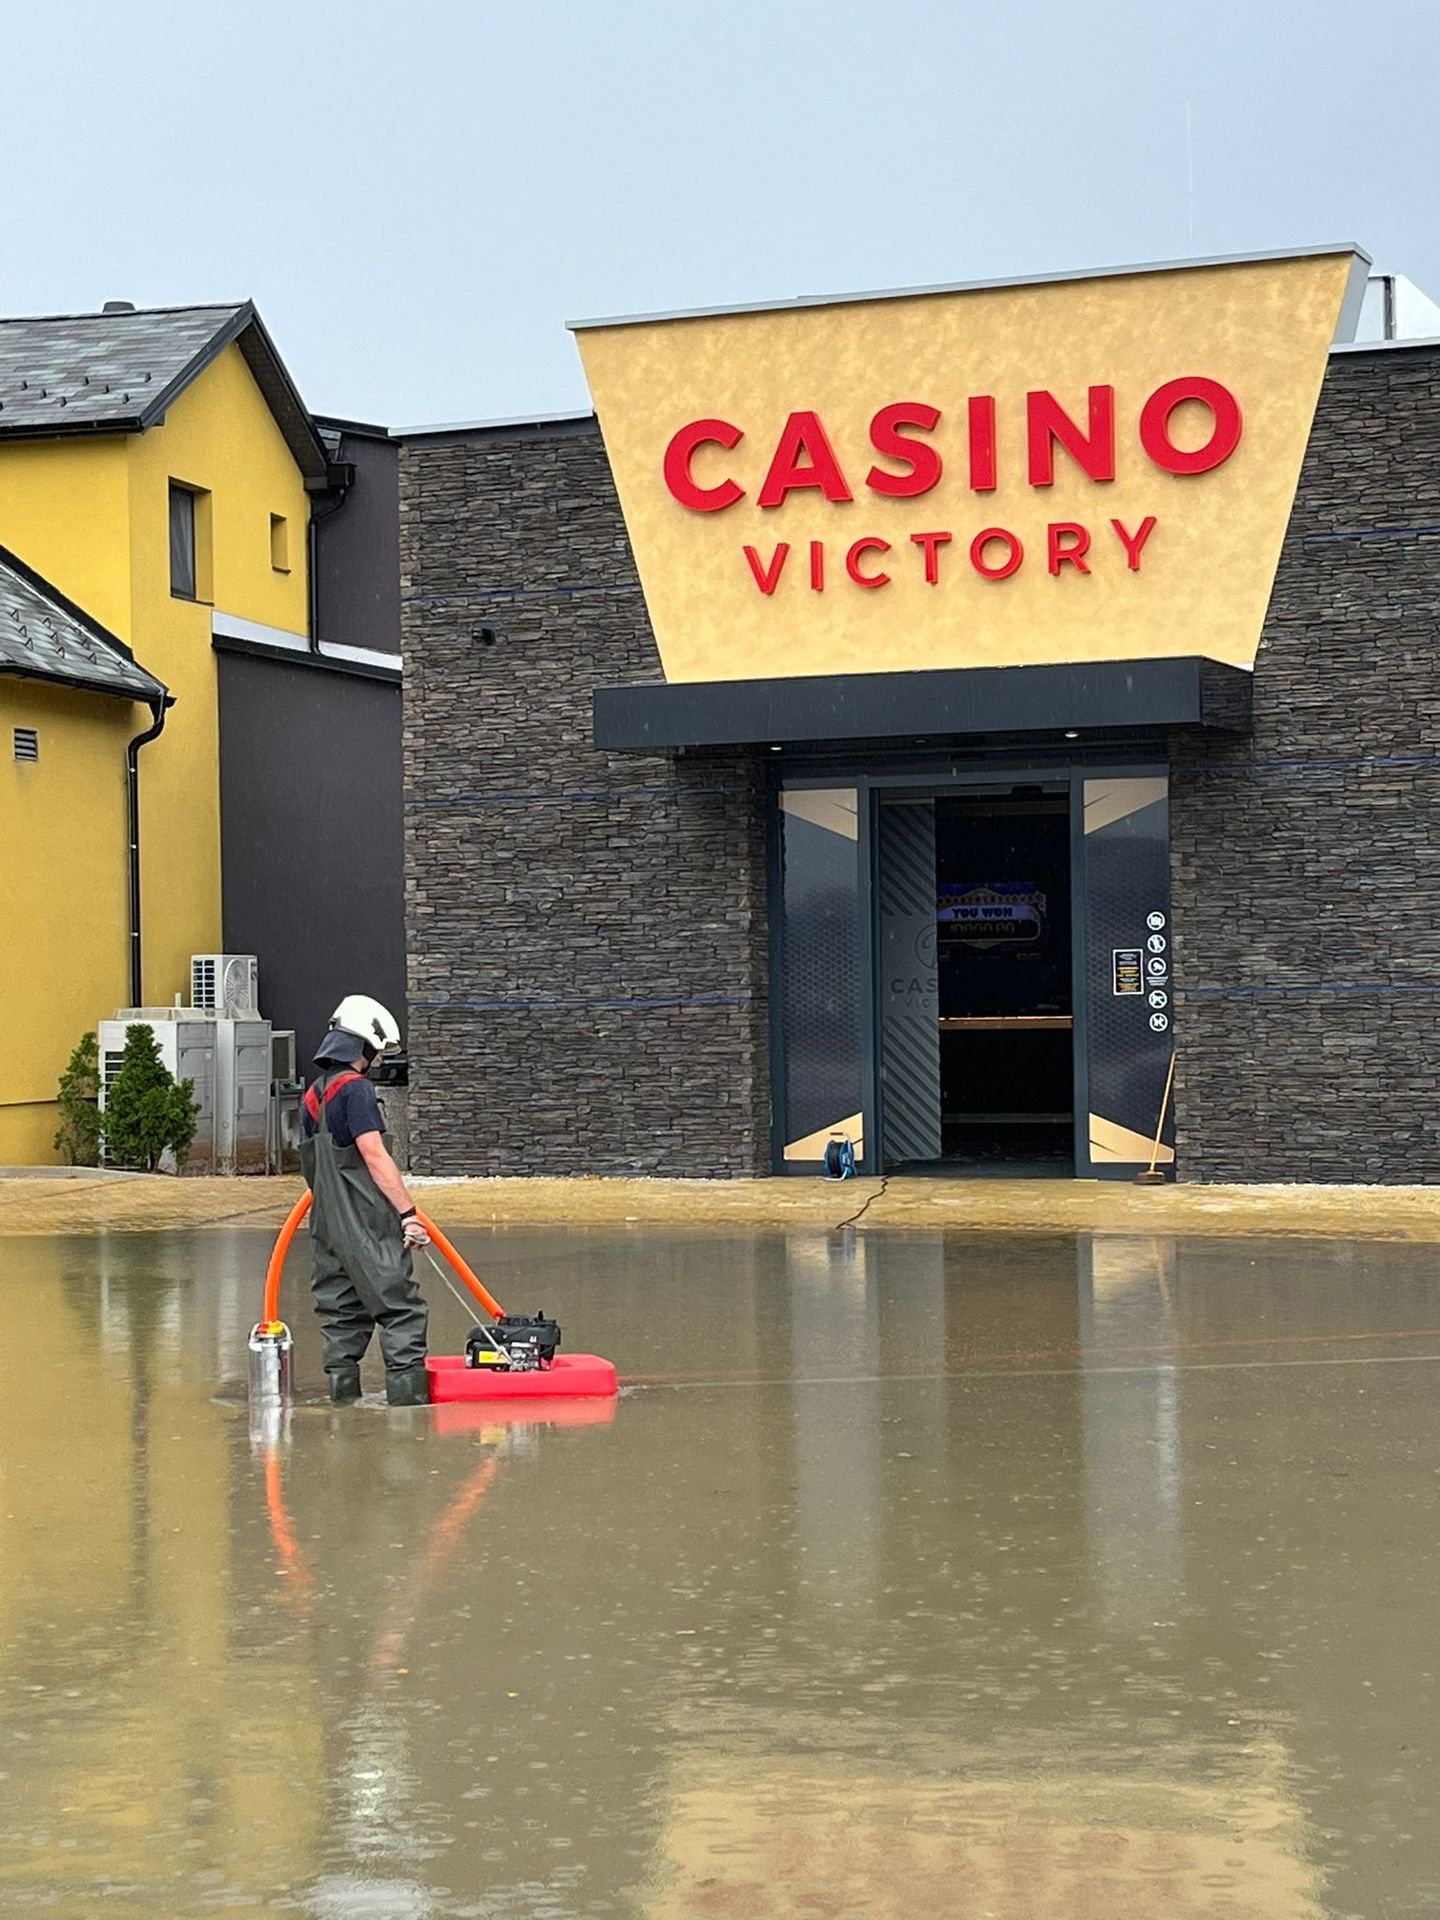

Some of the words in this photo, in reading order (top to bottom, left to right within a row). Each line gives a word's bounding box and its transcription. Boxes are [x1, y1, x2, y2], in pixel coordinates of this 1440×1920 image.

[664, 377, 1242, 513] CASINO
[744, 517, 1156, 595] VICTORY
[952, 908, 978, 918] YOU
[981, 907, 1013, 918] WON
